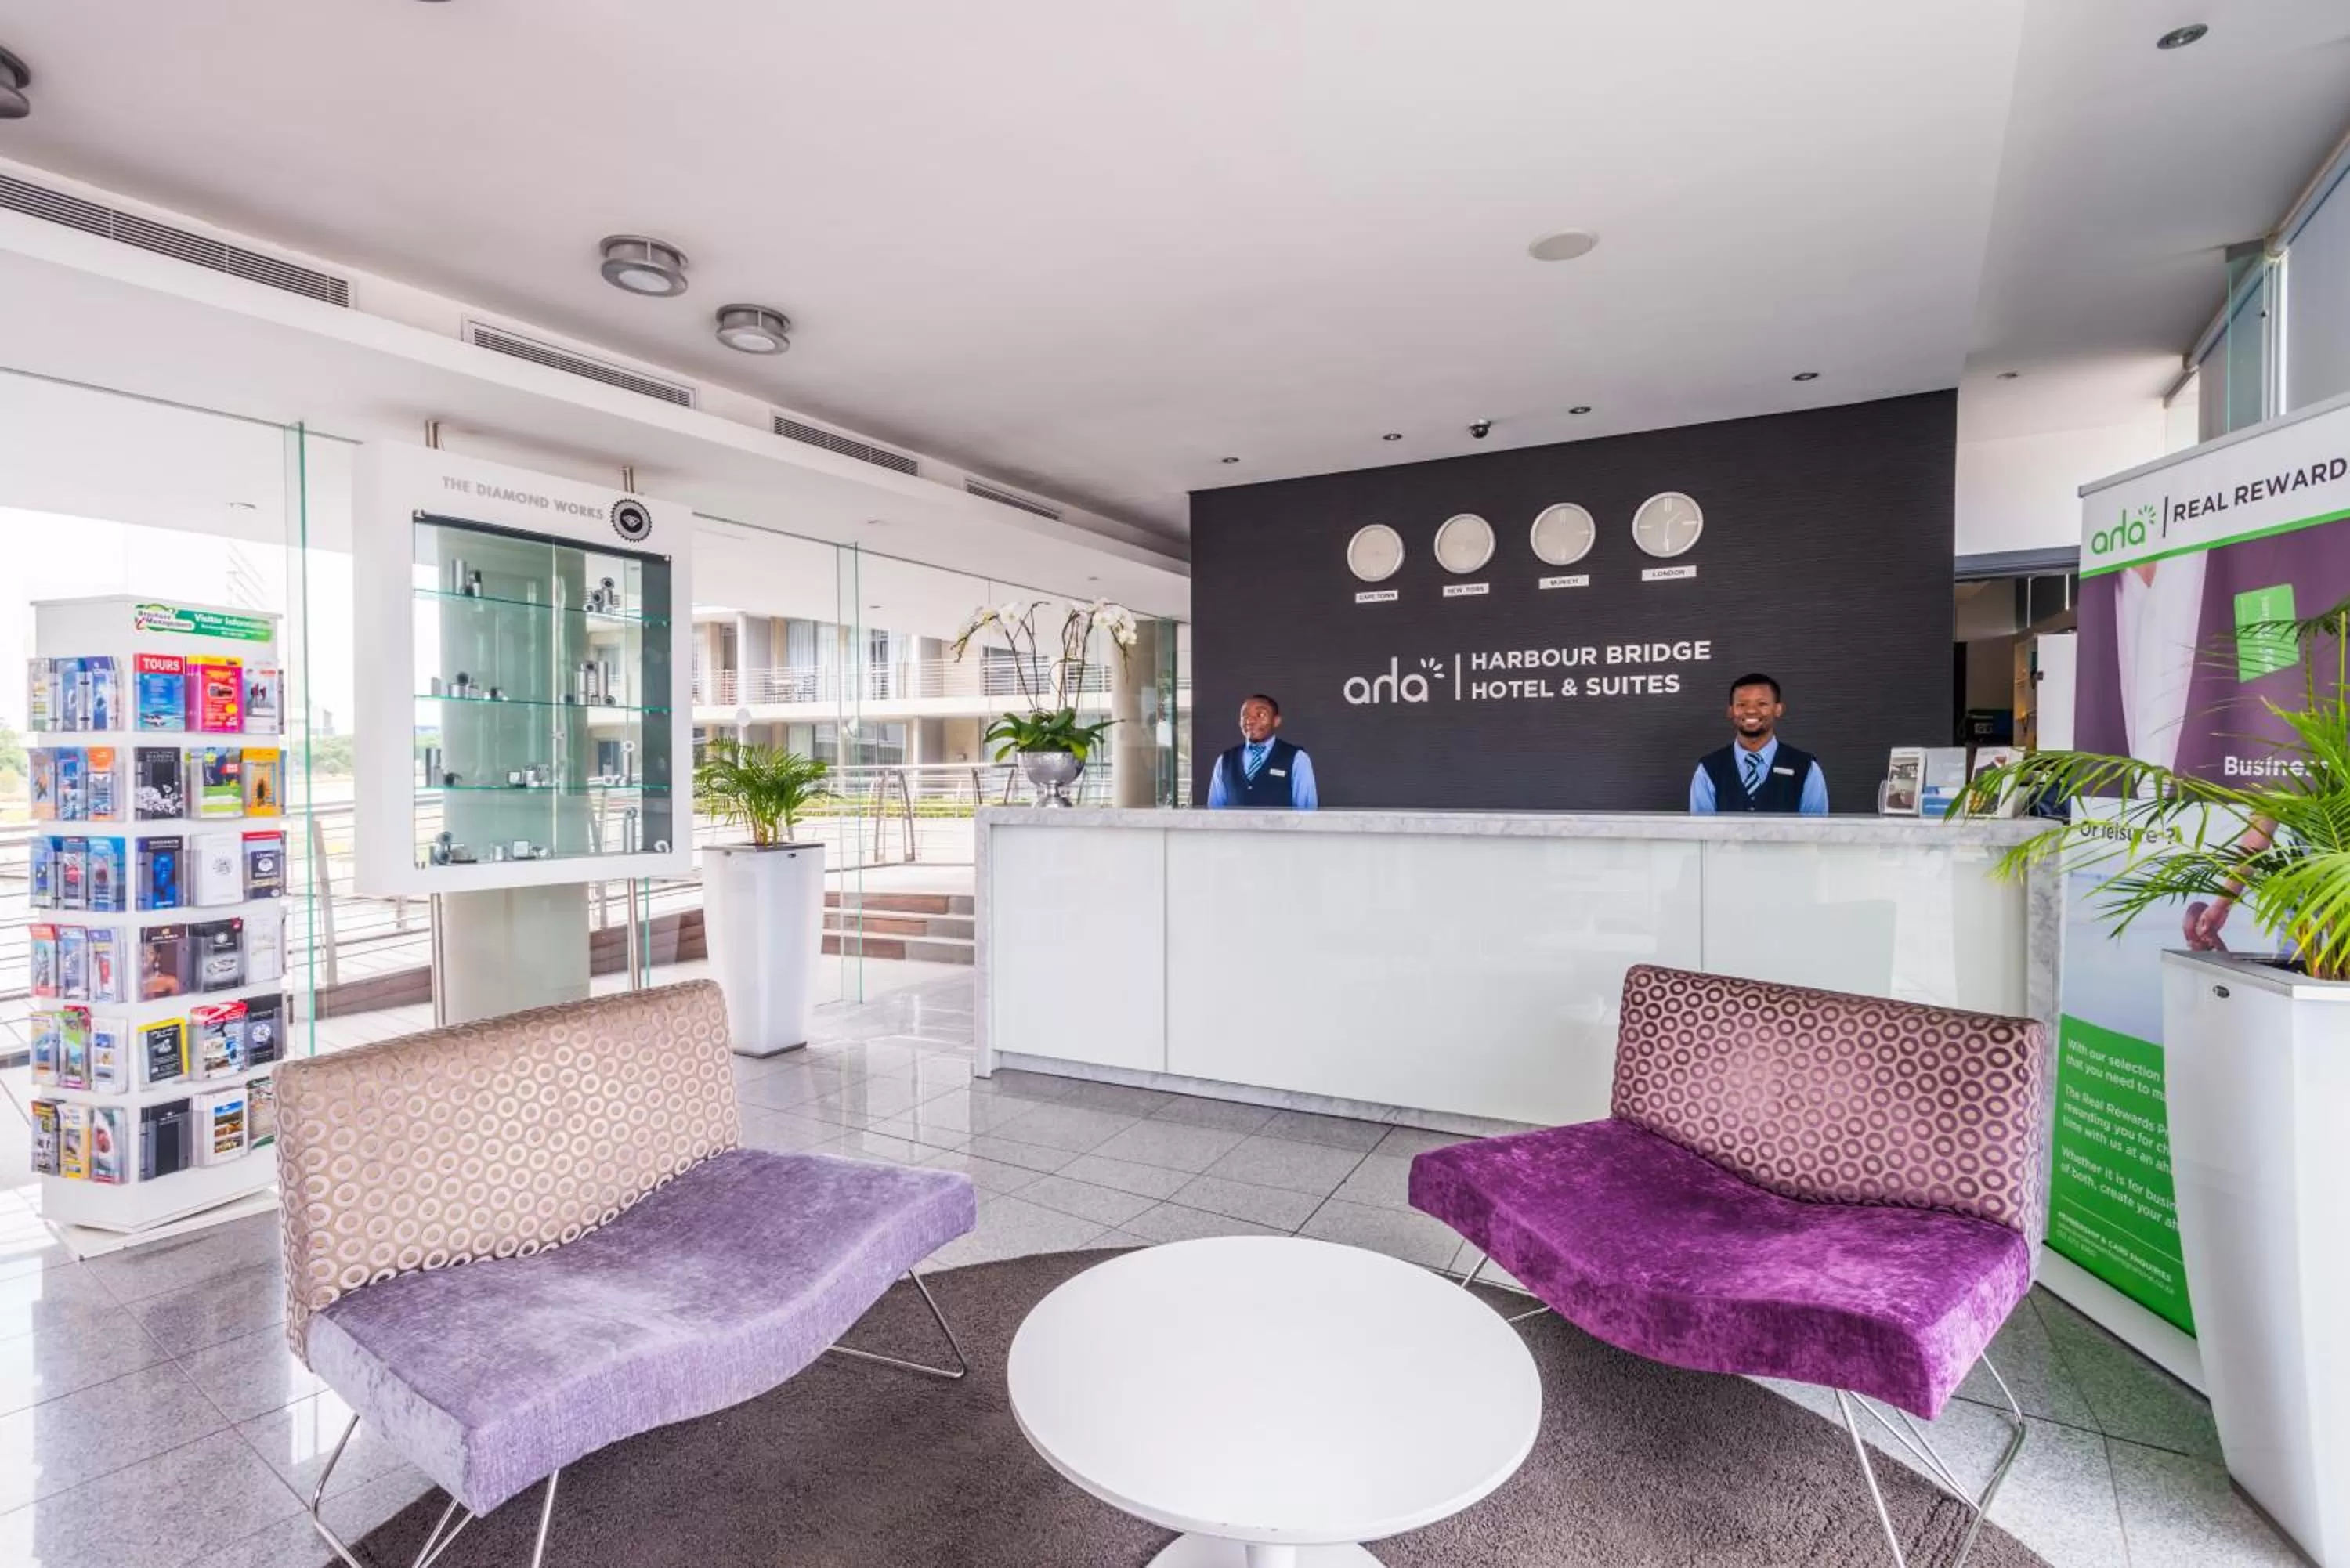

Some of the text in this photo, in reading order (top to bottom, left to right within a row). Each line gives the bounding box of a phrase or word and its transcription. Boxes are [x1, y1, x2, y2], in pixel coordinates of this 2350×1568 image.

[442, 475, 604, 521] THE DIAMOND WORKS
[2173, 492, 2229, 523] REAL
[1652, 569, 1685, 578] LONDON
[142, 657, 180, 671] TOURS
[1471, 640, 1712, 671] HARBOUR BRIDGE
[1471, 674, 1681, 700] HOTEL & SUITES
[2224, 754, 2330, 778] Busine
[2080, 820, 2099, 837] Or
[2101, 823, 2158, 844] leisue
[2066, 1053, 2084, 1071] that
[2084, 1064, 2104, 1078] you
[2105, 1071, 2135, 1090] need
[2138, 1082, 2150, 1095] to
[2067, 1037, 2160, 1082] With our selection
[2063, 1103, 2112, 1132] rewarding
[2113, 1124, 2135, 1140] you
[2138, 1132, 2154, 1149] for
[2065, 1083, 2081, 1100] The
[2082, 1091, 2103, 1110] Real
[2106, 1102, 2155, 1133] Rewards
[2063, 1115, 2082, 1134] time
[2084, 1128, 2107, 1146] with
[2110, 1138, 2122, 1152] us
[2125, 1146, 2138, 1158] at
[2139, 1151, 2153, 1166] an
[2061, 1143, 2102, 1175] Whether
[2105, 1165, 2113, 1181] it
[2116, 1172, 2125, 1186] is
[2128, 1178, 2144, 1194] for
[2099, 1183, 2135, 1207] create
[2136, 1201, 2163, 1223] your
